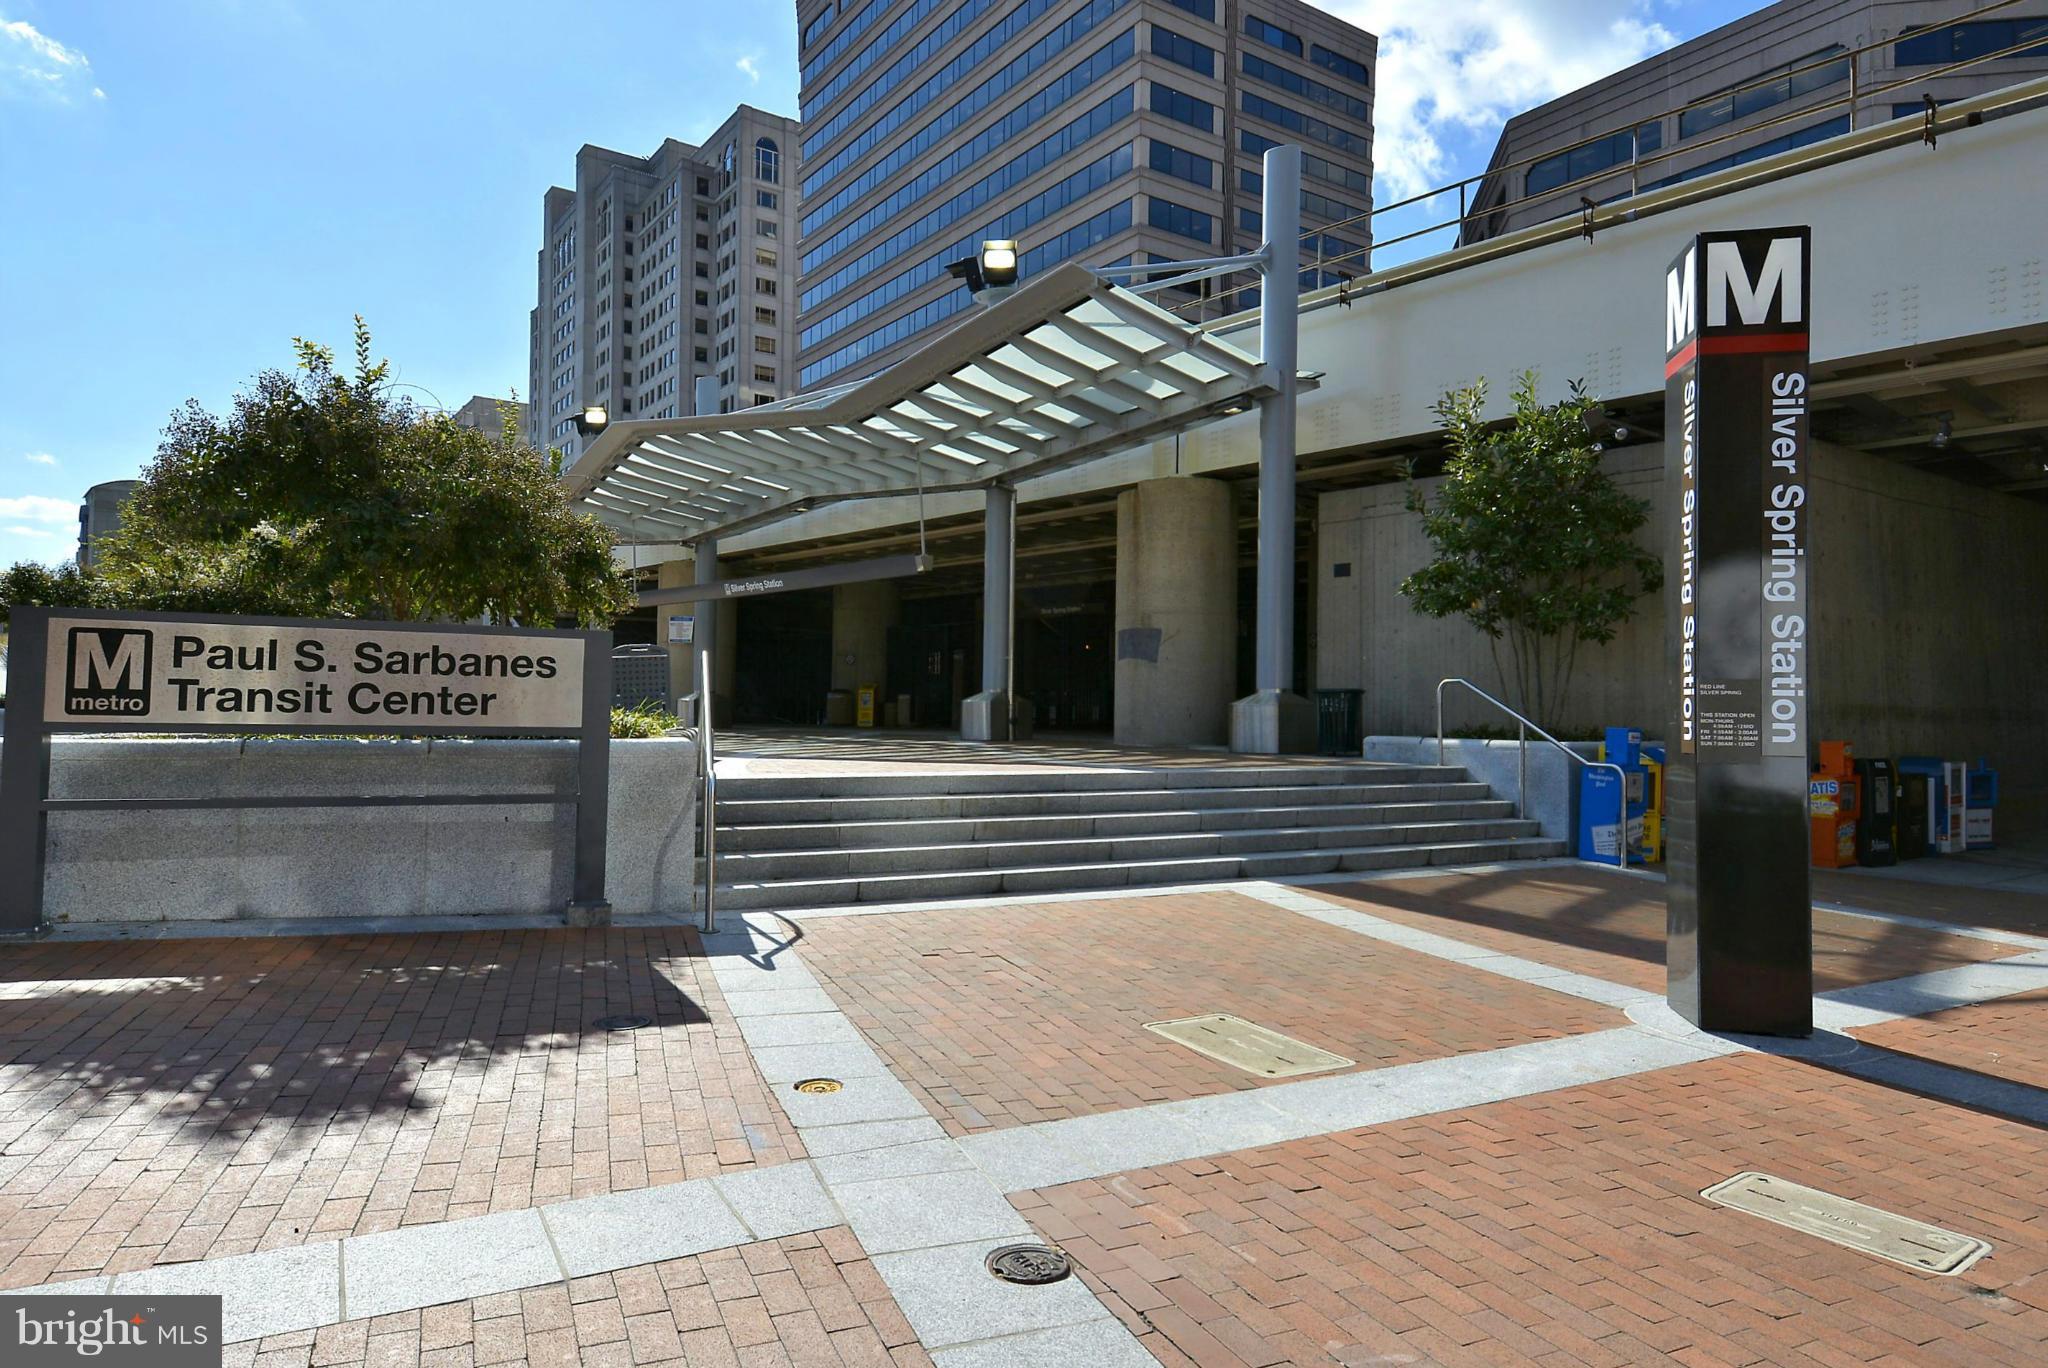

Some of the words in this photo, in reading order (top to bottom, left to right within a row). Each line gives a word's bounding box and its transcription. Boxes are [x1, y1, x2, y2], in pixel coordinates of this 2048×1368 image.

[1667, 246, 1695, 353] M
[1707, 237, 1802, 327] M
[1683, 379, 1696, 479] Silver
[1771, 372, 1805, 474] Silver
[1681, 489, 1695, 604] Spring
[1763, 484, 1805, 602] Spring
[71, 695, 144, 711] metro
[74, 632, 145, 690] M
[167, 678, 333, 714] Transit
[347, 682, 497, 716] Center
[172, 635, 278, 671] Paul
[294, 639, 337, 672] S.
[353, 641, 557, 679] Sarbanes
[1683, 615, 1695, 741] Station
[1771, 614, 1805, 743] Station
[1810, 781, 1839, 794] ATIS
